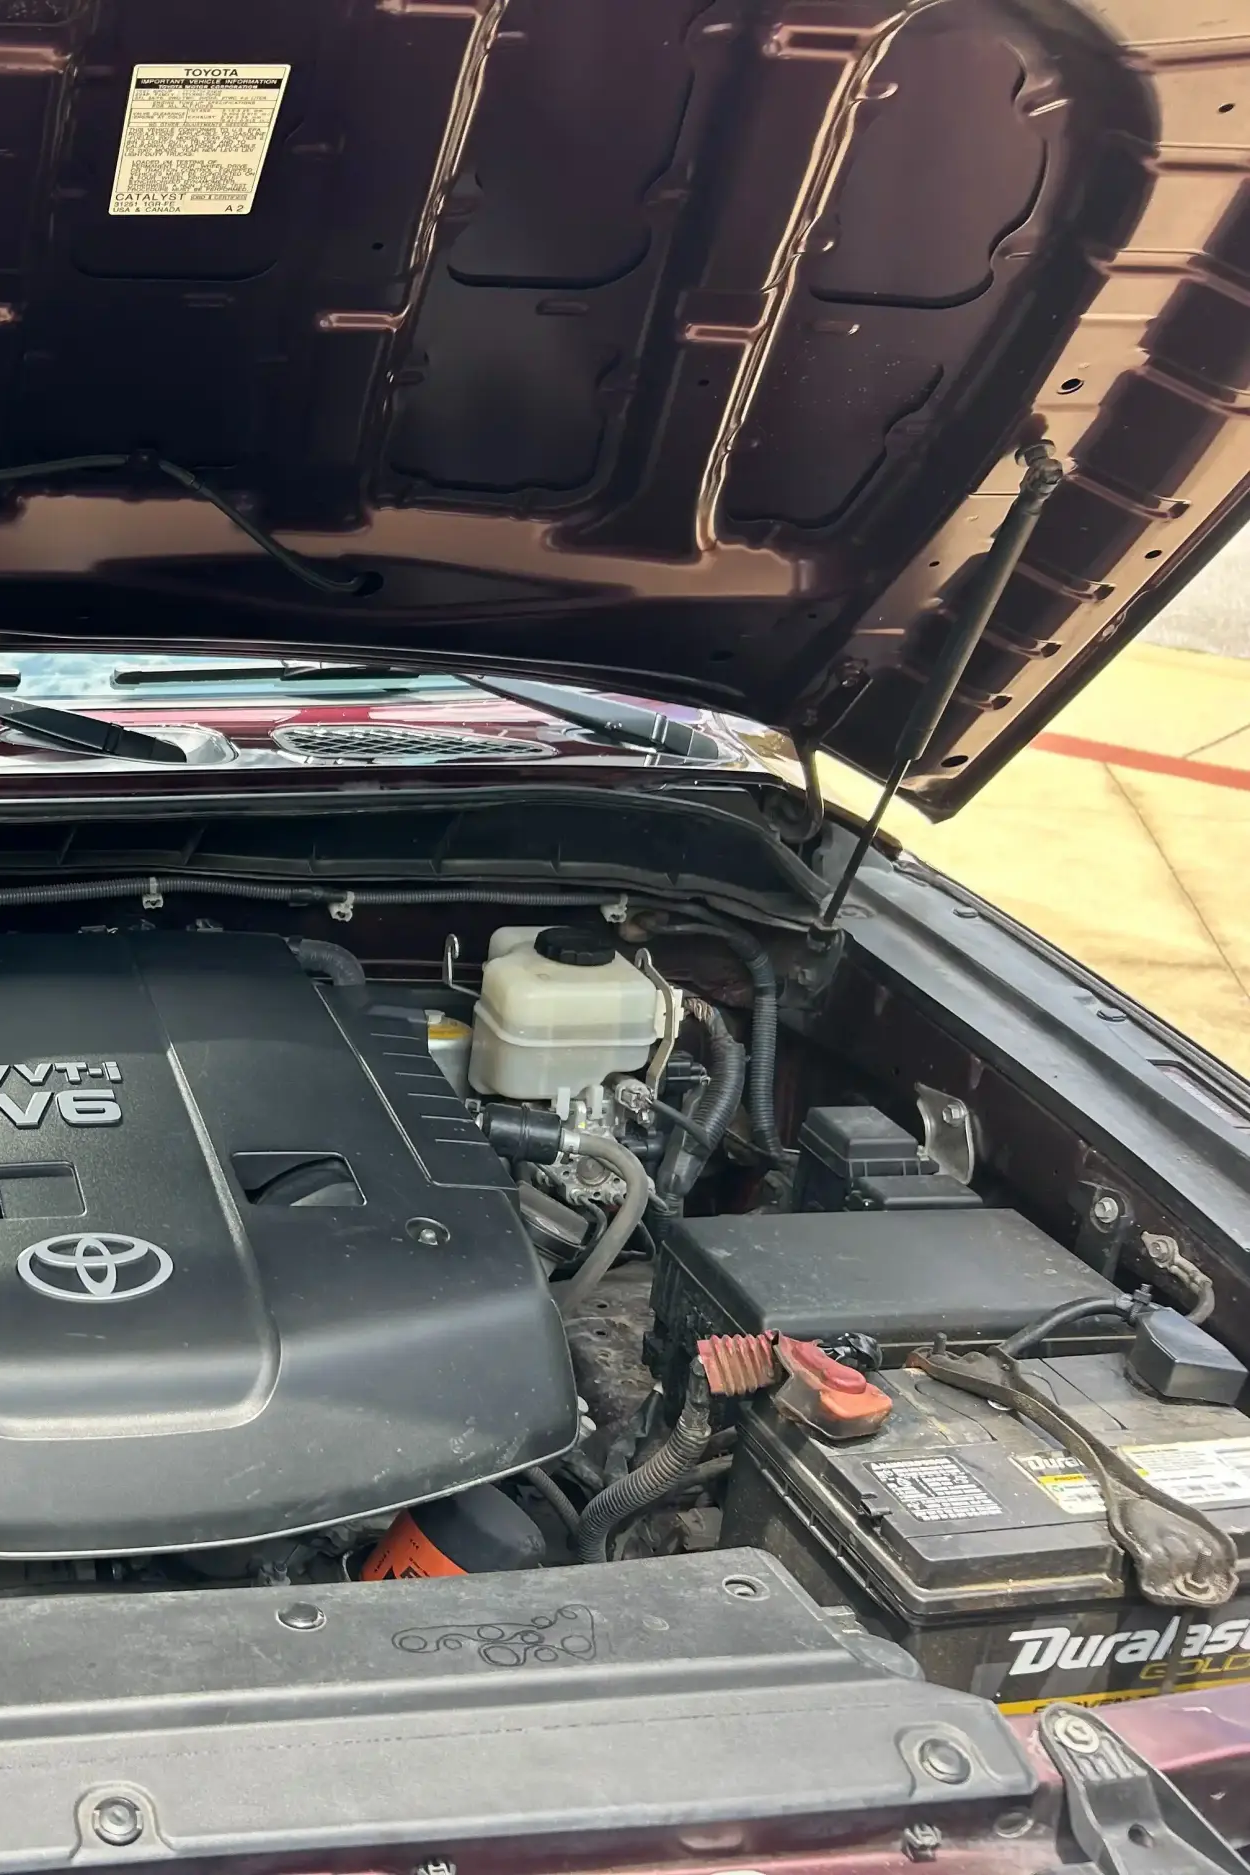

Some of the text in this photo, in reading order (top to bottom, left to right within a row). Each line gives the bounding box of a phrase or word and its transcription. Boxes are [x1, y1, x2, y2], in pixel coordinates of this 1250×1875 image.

[184, 68, 239, 77] TOYOTA
[115, 193, 185, 201] CATALYST
[1008, 1615, 1250, 1676] Duralas
